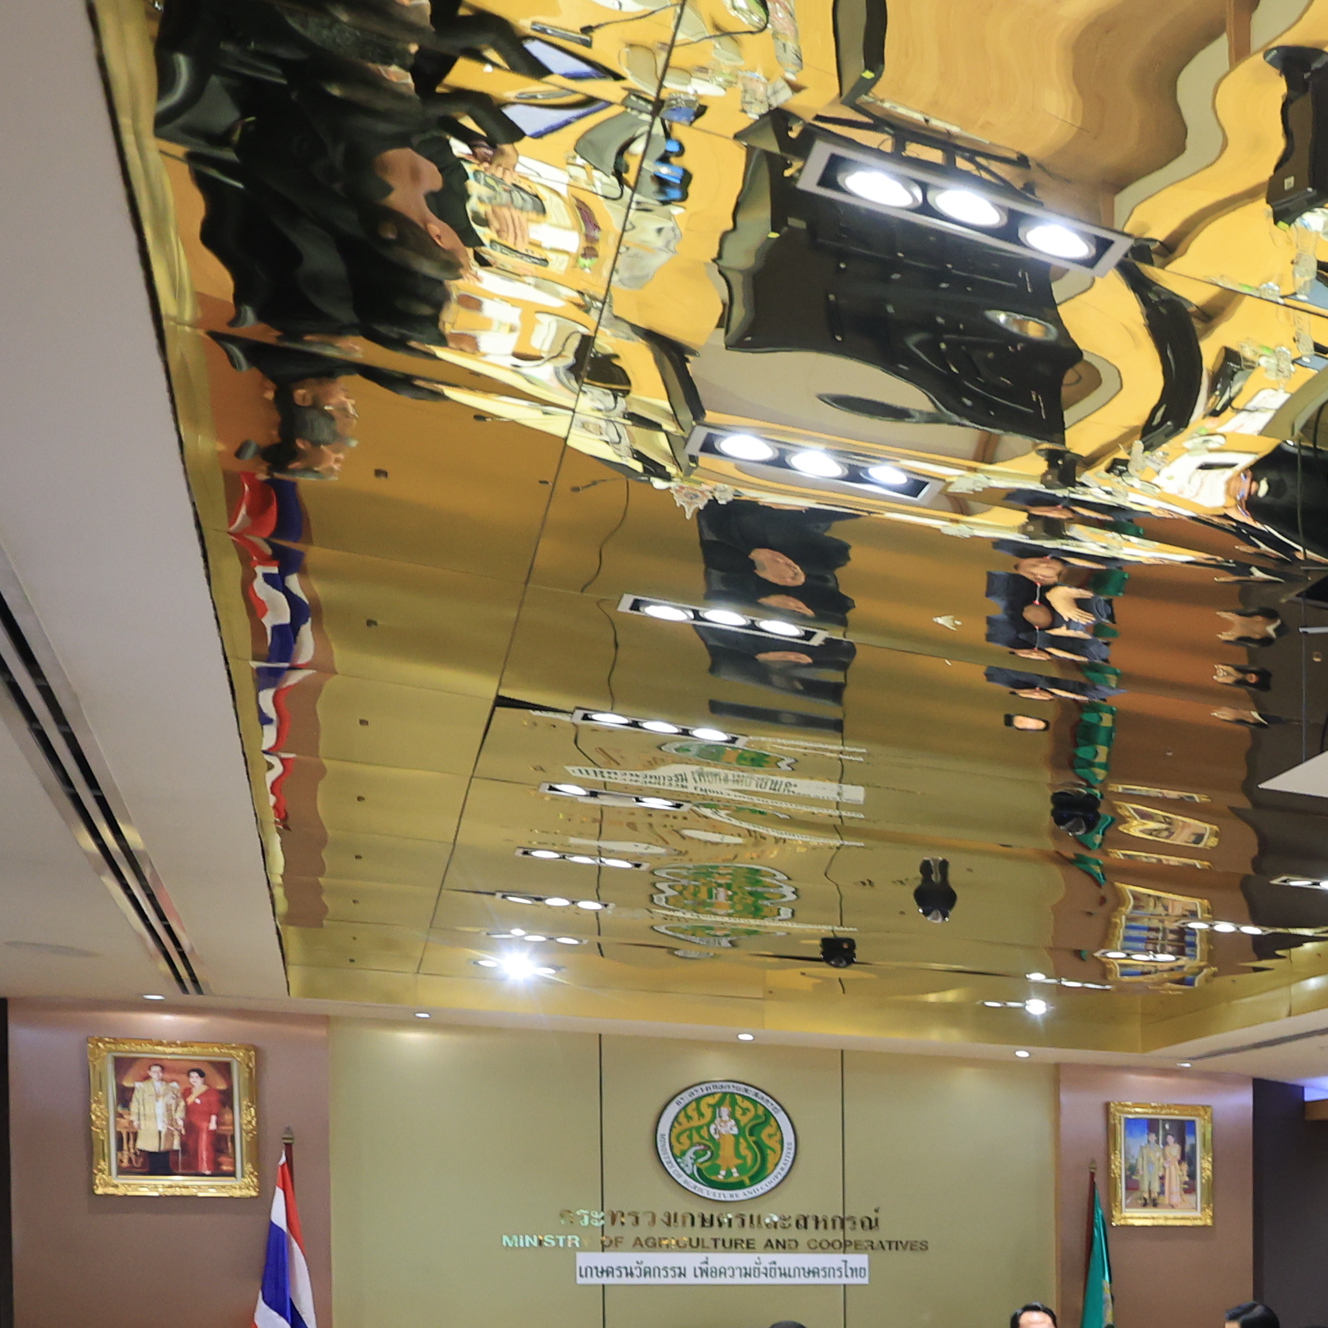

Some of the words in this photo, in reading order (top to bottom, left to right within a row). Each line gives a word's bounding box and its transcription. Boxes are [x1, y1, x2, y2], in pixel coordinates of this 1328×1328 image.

[559, 1207, 880, 1231] กระทรวงเกษตรและสหกรณ์
[502, 1234, 592, 1248] MINISTRY
[601, 1236, 624, 1249] OF
[632, 1236, 756, 1250] AGRICULTURE
[764, 1237, 799, 1250] AND
[807, 1238, 929, 1251] COOPERATIVES
[578, 1260, 687, 1279] เกษตรนวัตกรรม
